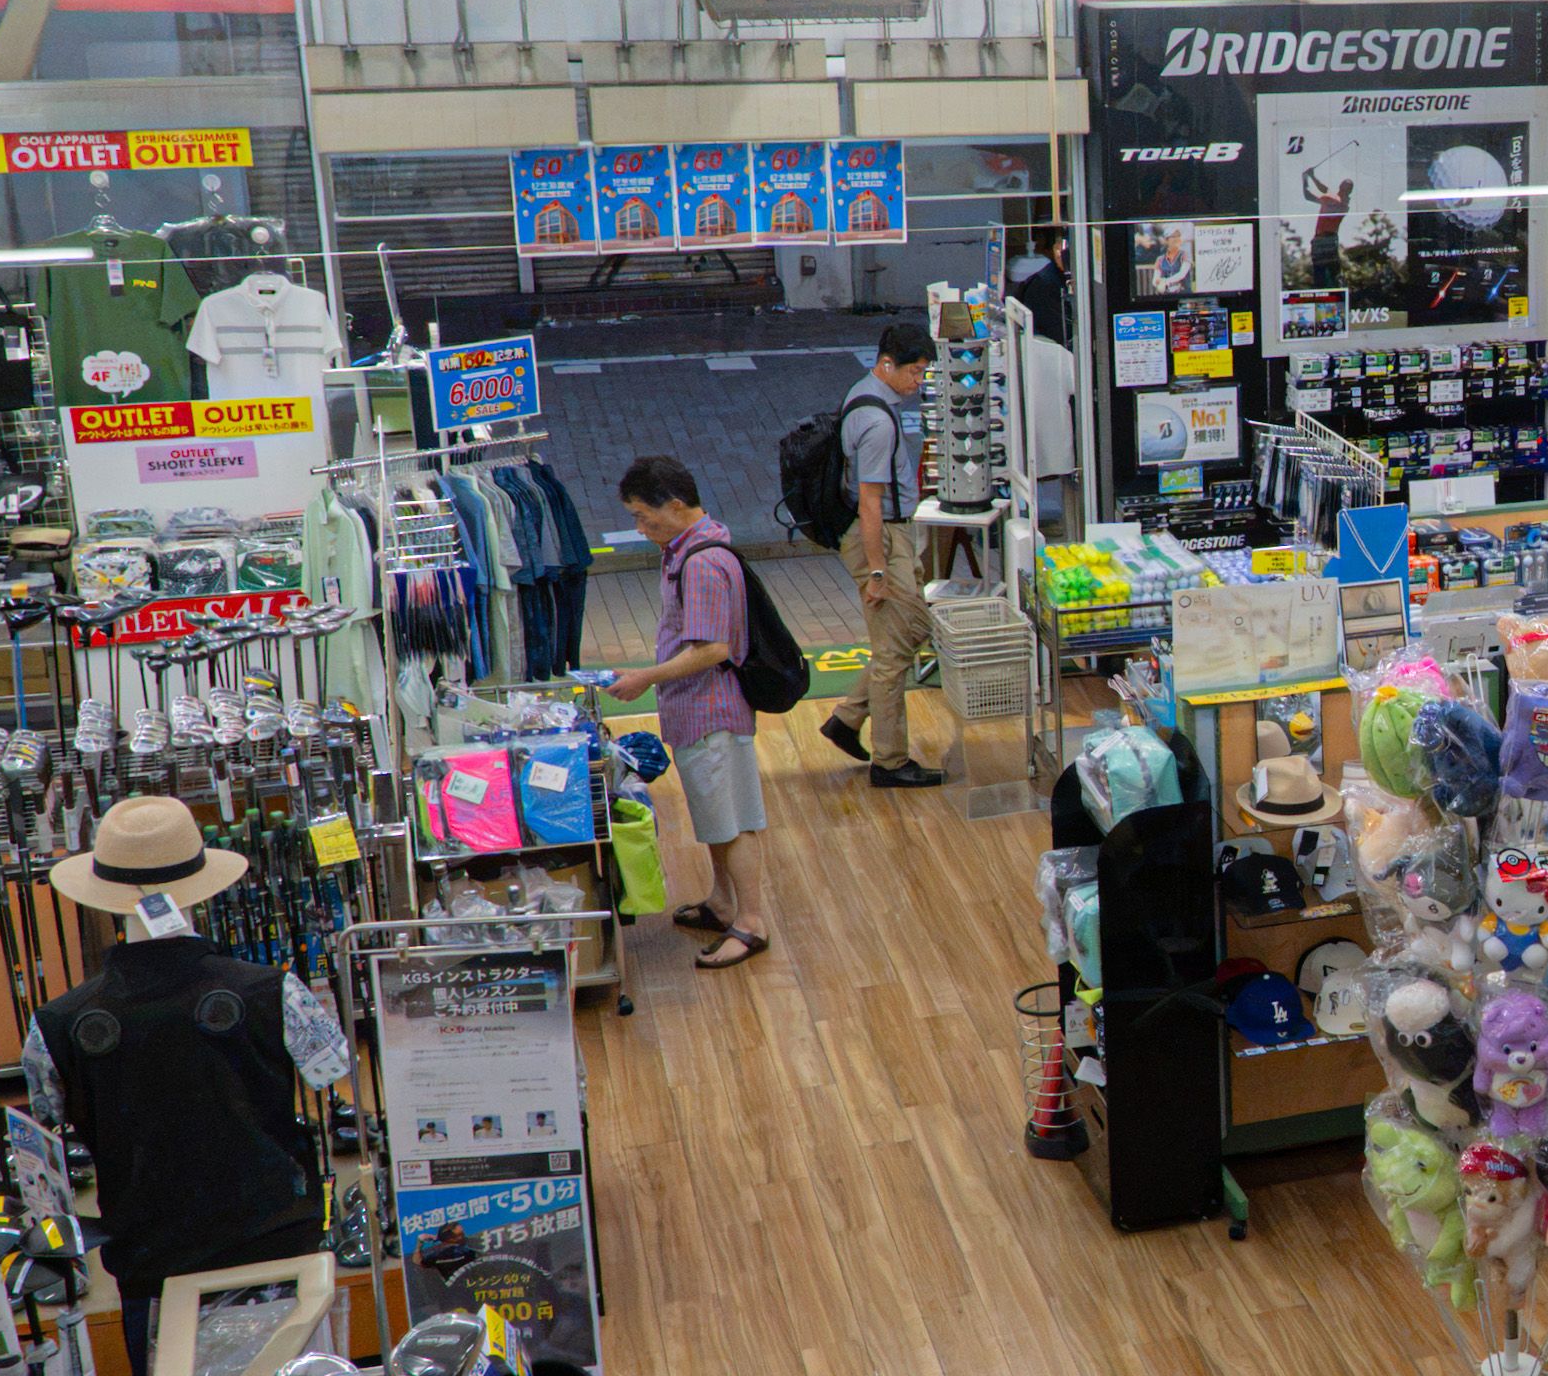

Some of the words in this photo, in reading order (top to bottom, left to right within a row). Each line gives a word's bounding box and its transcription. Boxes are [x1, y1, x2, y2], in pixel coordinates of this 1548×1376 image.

[1160, 26, 1512, 78] BRIDGESTONE
[1342, 94, 1471, 114] BRIDGESTONE
[19, 134, 51, 146] GOLF
[54, 133, 108, 145] APPAREL
[11, 144, 122, 169] OUTLET
[136, 141, 240, 165] OUTLET
[92, 370, 110, 382] 4F
[81, 407, 175, 428] OUTLET
[205, 403, 295, 423] OUTLET
[475, 405, 500, 415] SALE
[1191, 408, 1227, 428] No.1
[149, 458, 195, 471] SHORT
[199, 456, 244, 468] SLEEVE
[1181, 534, 1246, 551] DGESTONE
[1301, 585, 1330, 602] UV
[402, 967, 545, 985] KGSインストラクター
[433, 985, 517, 1001] 個人レッスン
[434, 1001, 519, 1018] ご予約受付中
[402, 1180, 578, 1235] 快適空間で50分
[480, 1206, 581, 1252] 打ち放題
